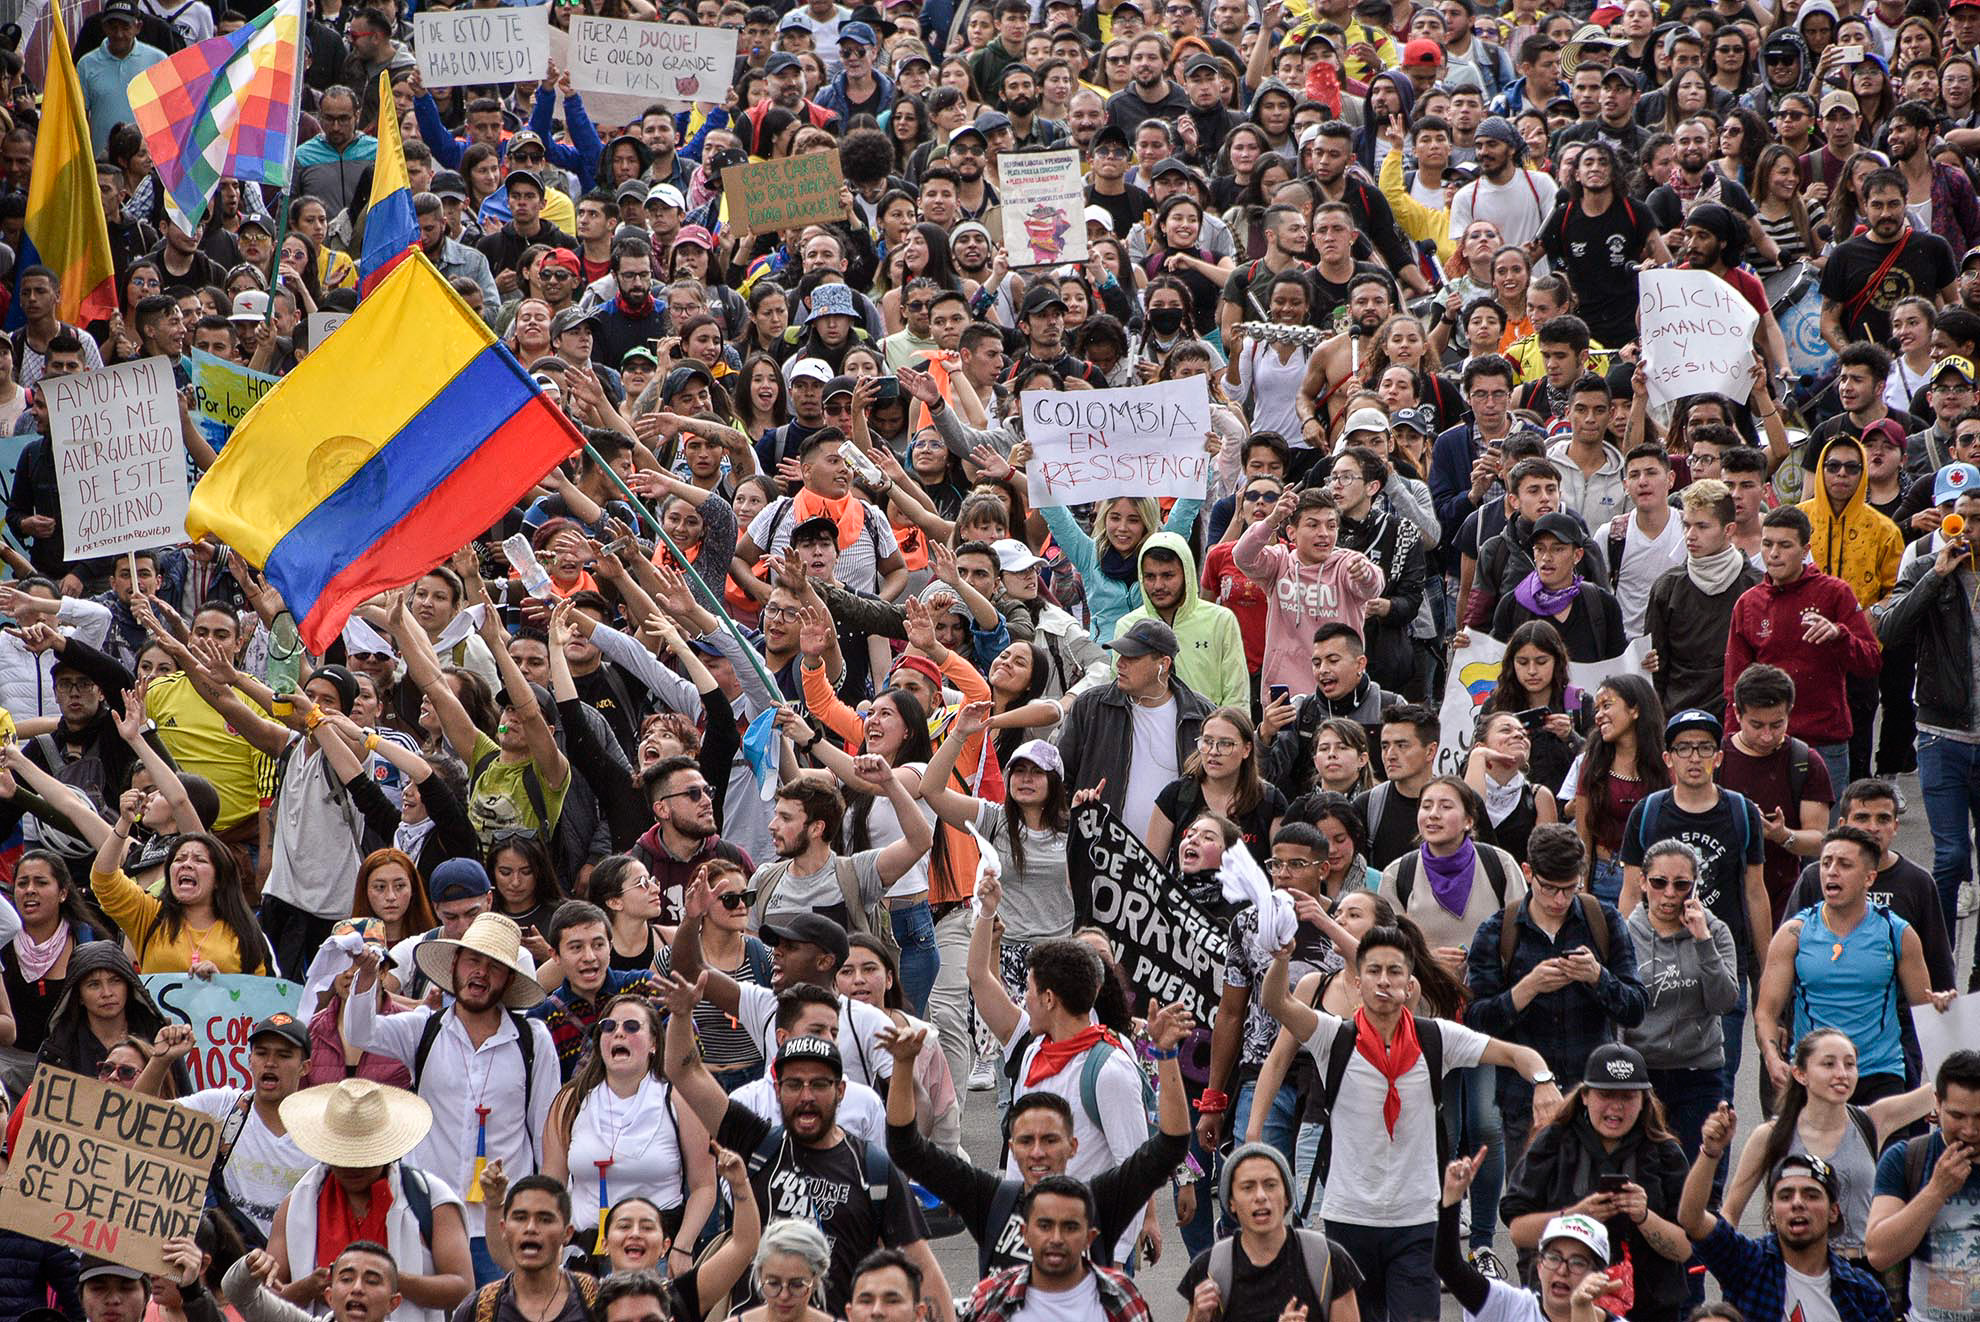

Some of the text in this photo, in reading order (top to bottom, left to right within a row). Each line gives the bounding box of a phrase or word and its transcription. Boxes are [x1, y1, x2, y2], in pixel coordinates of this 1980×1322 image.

[454, 16, 490, 43] ESTO
[497, 14, 524, 42] TE
[595, 68, 609, 84] EL
[607, 48, 653, 67] QUEDO
[662, 56, 717, 72] GRANDE
[784, 156, 830, 179] CARTEL
[1642, 282, 1745, 313] OLICIA
[1673, 337, 1688, 357] Y
[132, 363, 159, 396] MI
[195, 385, 219, 414] Por
[71, 399, 160, 441] PAIS ME
[1033, 399, 1197, 437] COLOMBIA
[63, 426, 173, 475] AVERGUENZO
[1069, 430, 1110, 453] EN
[78, 475, 105, 505] DE
[113, 456, 175, 496] ESTE
[1040, 452, 1207, 496] RESISTENCIA
[78, 491, 163, 541] GOBIERNO
[1277, 578, 1338, 608] OPEN
[1078, 808, 1103, 839] EL
[1682, 832, 1727, 857] SPACE
[1094, 846, 1128, 880] DE
[32, 1066, 84, 1127] ¡EL
[26, 1129, 70, 1169] NO
[72, 1138, 117, 1180] SE
[124, 1152, 208, 1211] VENDE
[19, 1164, 200, 1240] SE DEFIENDE
[771, 1170, 850, 1204] FUTURE
[777, 1191, 837, 1220] DAYS
[51, 1211, 120, 1253] 21N
